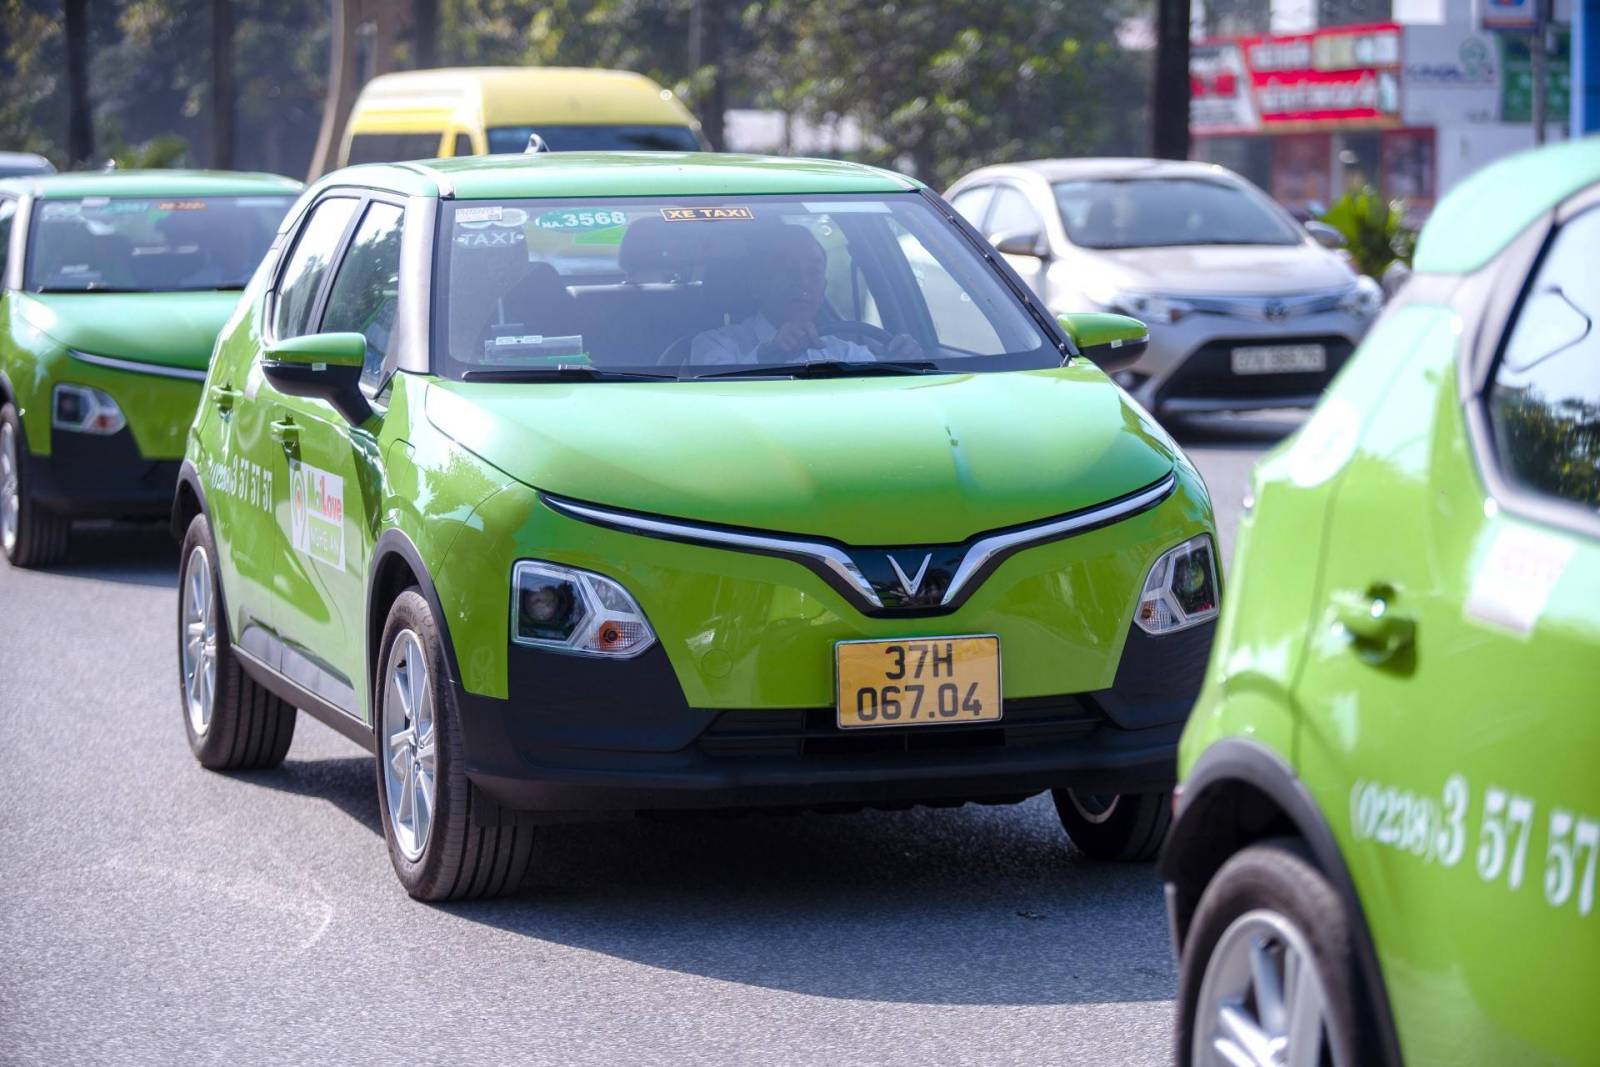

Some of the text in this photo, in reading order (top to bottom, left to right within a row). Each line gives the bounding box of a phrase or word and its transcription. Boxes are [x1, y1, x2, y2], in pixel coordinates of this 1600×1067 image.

[667, 208, 748, 219] XE TAXI
[461, 231, 516, 246] TAXI
[885, 643, 953, 680] 37H
[857, 682, 982, 721] 067.04
[1477, 785, 1536, 891] 57
[1545, 809, 1600, 917] 57
